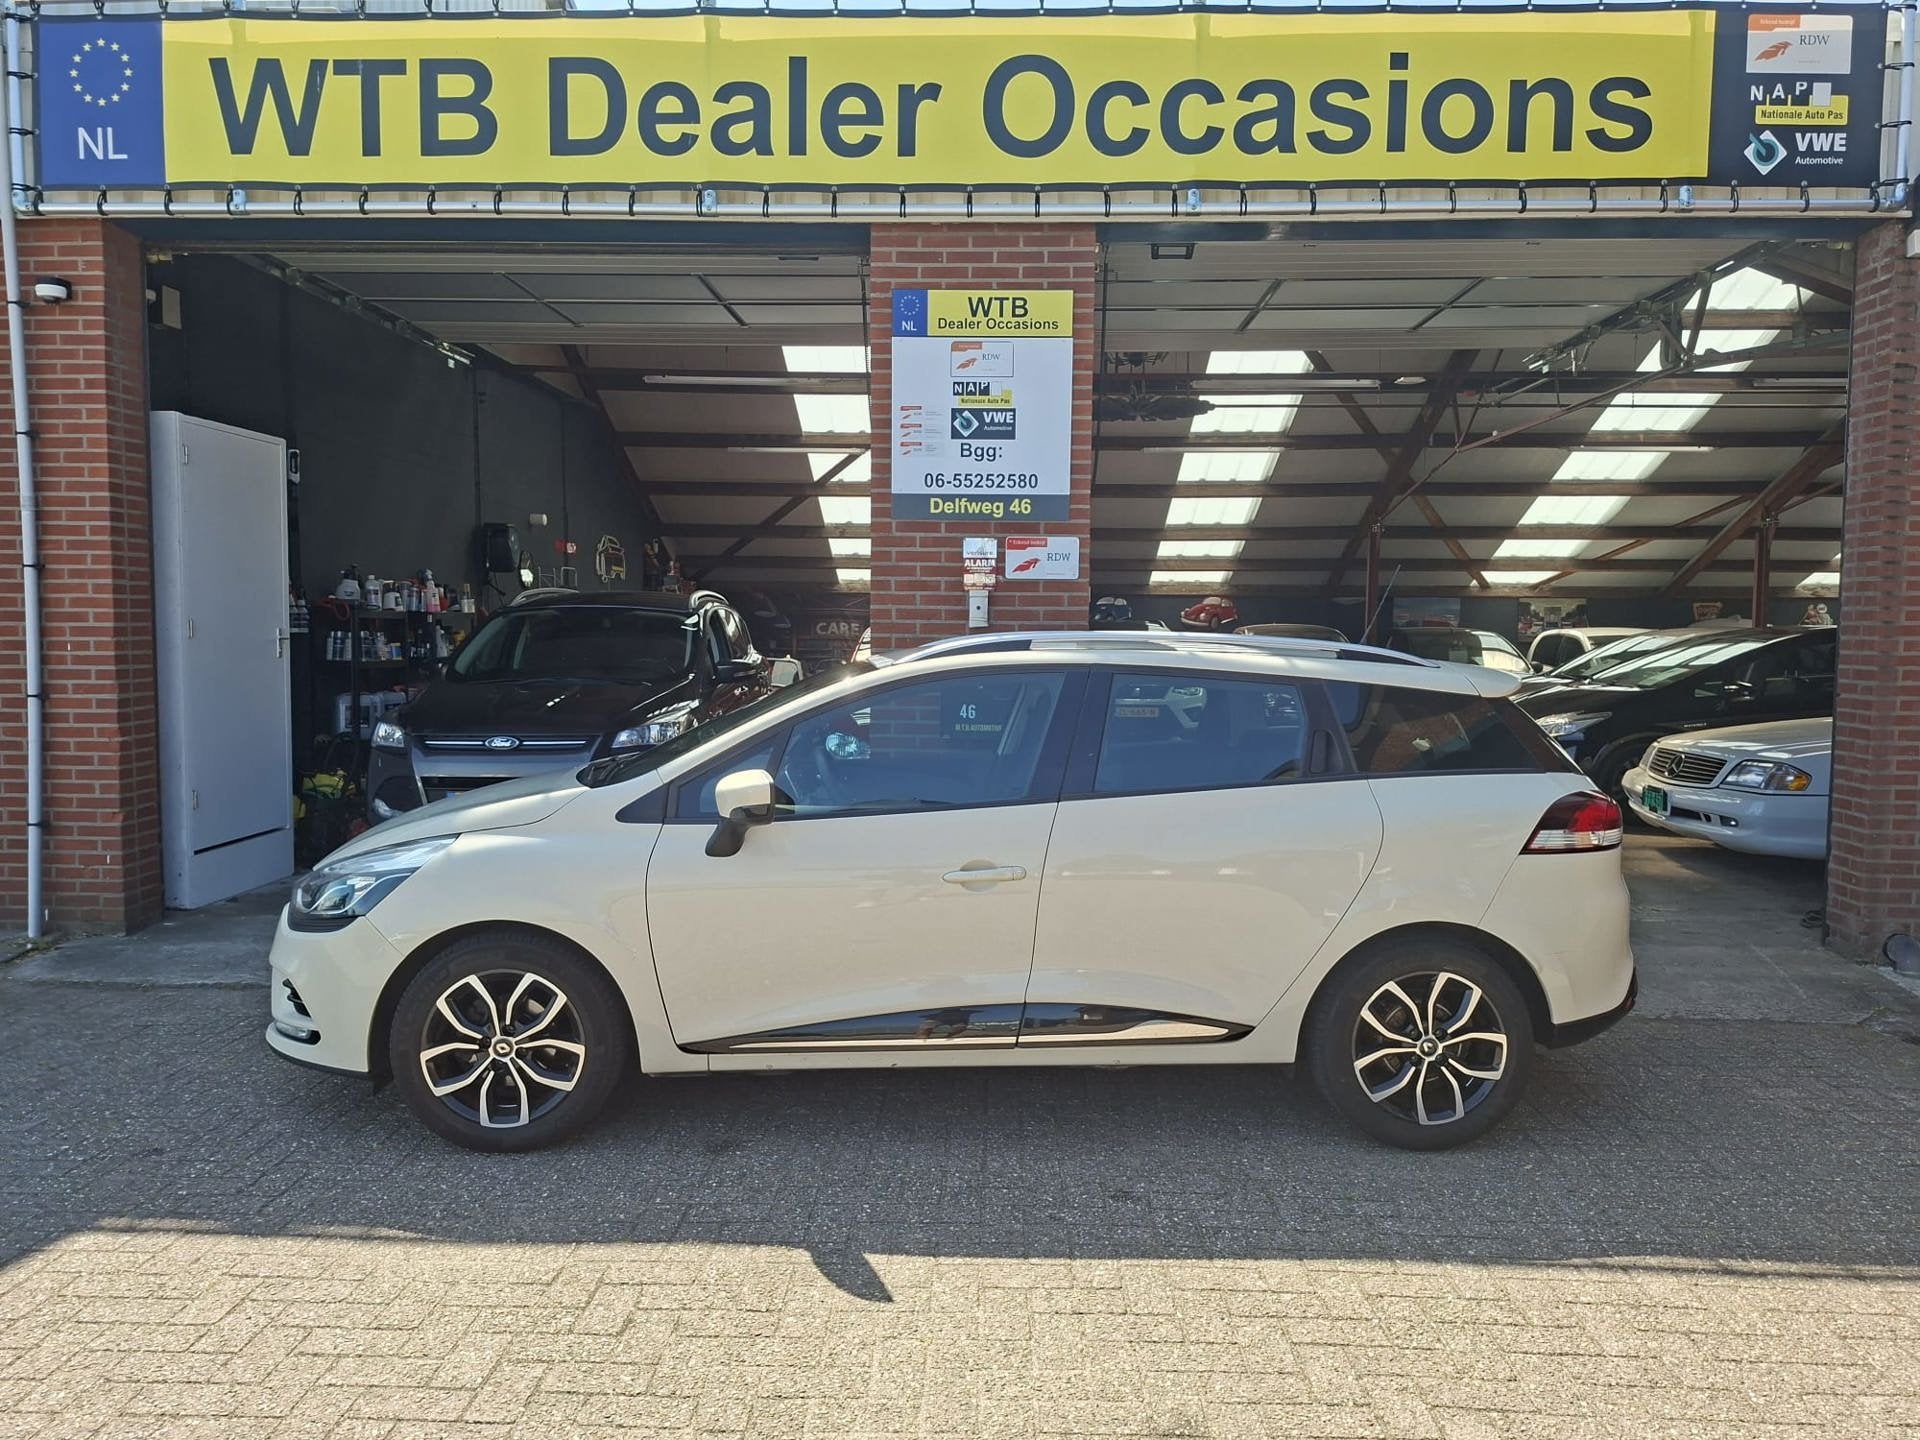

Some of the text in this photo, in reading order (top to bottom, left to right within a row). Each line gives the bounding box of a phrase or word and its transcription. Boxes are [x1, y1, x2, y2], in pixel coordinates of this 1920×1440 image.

[1799, 34, 1830, 46] RDW
[209, 51, 1654, 158] WTB Dealer Occasions
[1760, 109, 1844, 120] Nationale Auto Pas
[77, 127, 129, 160] NL
[1795, 132, 1847, 152] VWE
[1795, 156, 1844, 165] Automotive
[968, 297, 1029, 318] WTB
[901, 320, 917, 331] NL
[938, 318, 1059, 330] Dealer Occasions
[982, 353, 1000, 361] RDW
[983, 411, 1015, 423] VWE
[960, 443, 1003, 462] Bgg:
[924, 473, 1038, 489] 06-55252580
[930, 497, 1032, 518] Delfweg 46
[963, 558, 996, 568] ALARM
[1047, 552, 1071, 562] RDW
[815, 621, 861, 636] CARE
[959, 703, 976, 719] 46
